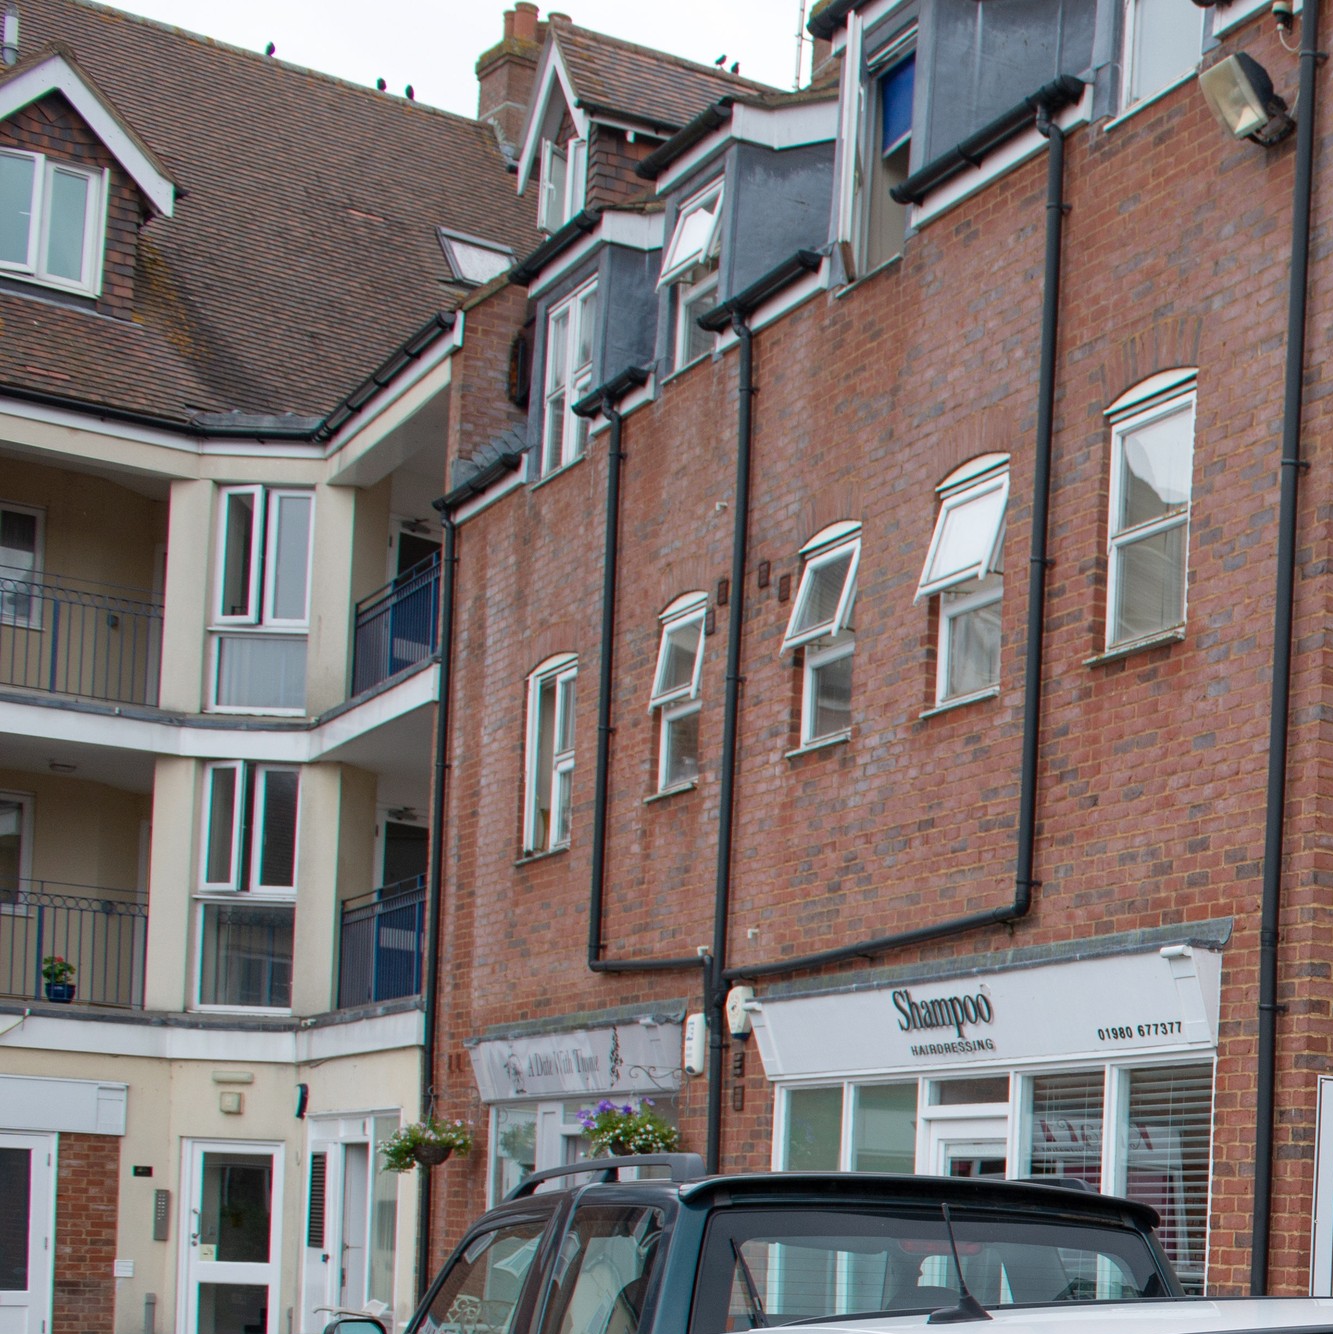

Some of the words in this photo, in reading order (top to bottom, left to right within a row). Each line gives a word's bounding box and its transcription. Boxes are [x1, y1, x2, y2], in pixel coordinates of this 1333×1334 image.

[892, 989, 992, 1038] Shampoo
[1098, 1027, 1133, 1040] 01980
[1137, 1021, 1182, 1037] 677377
[911, 1038, 994, 1056] HAIRDRESSING
